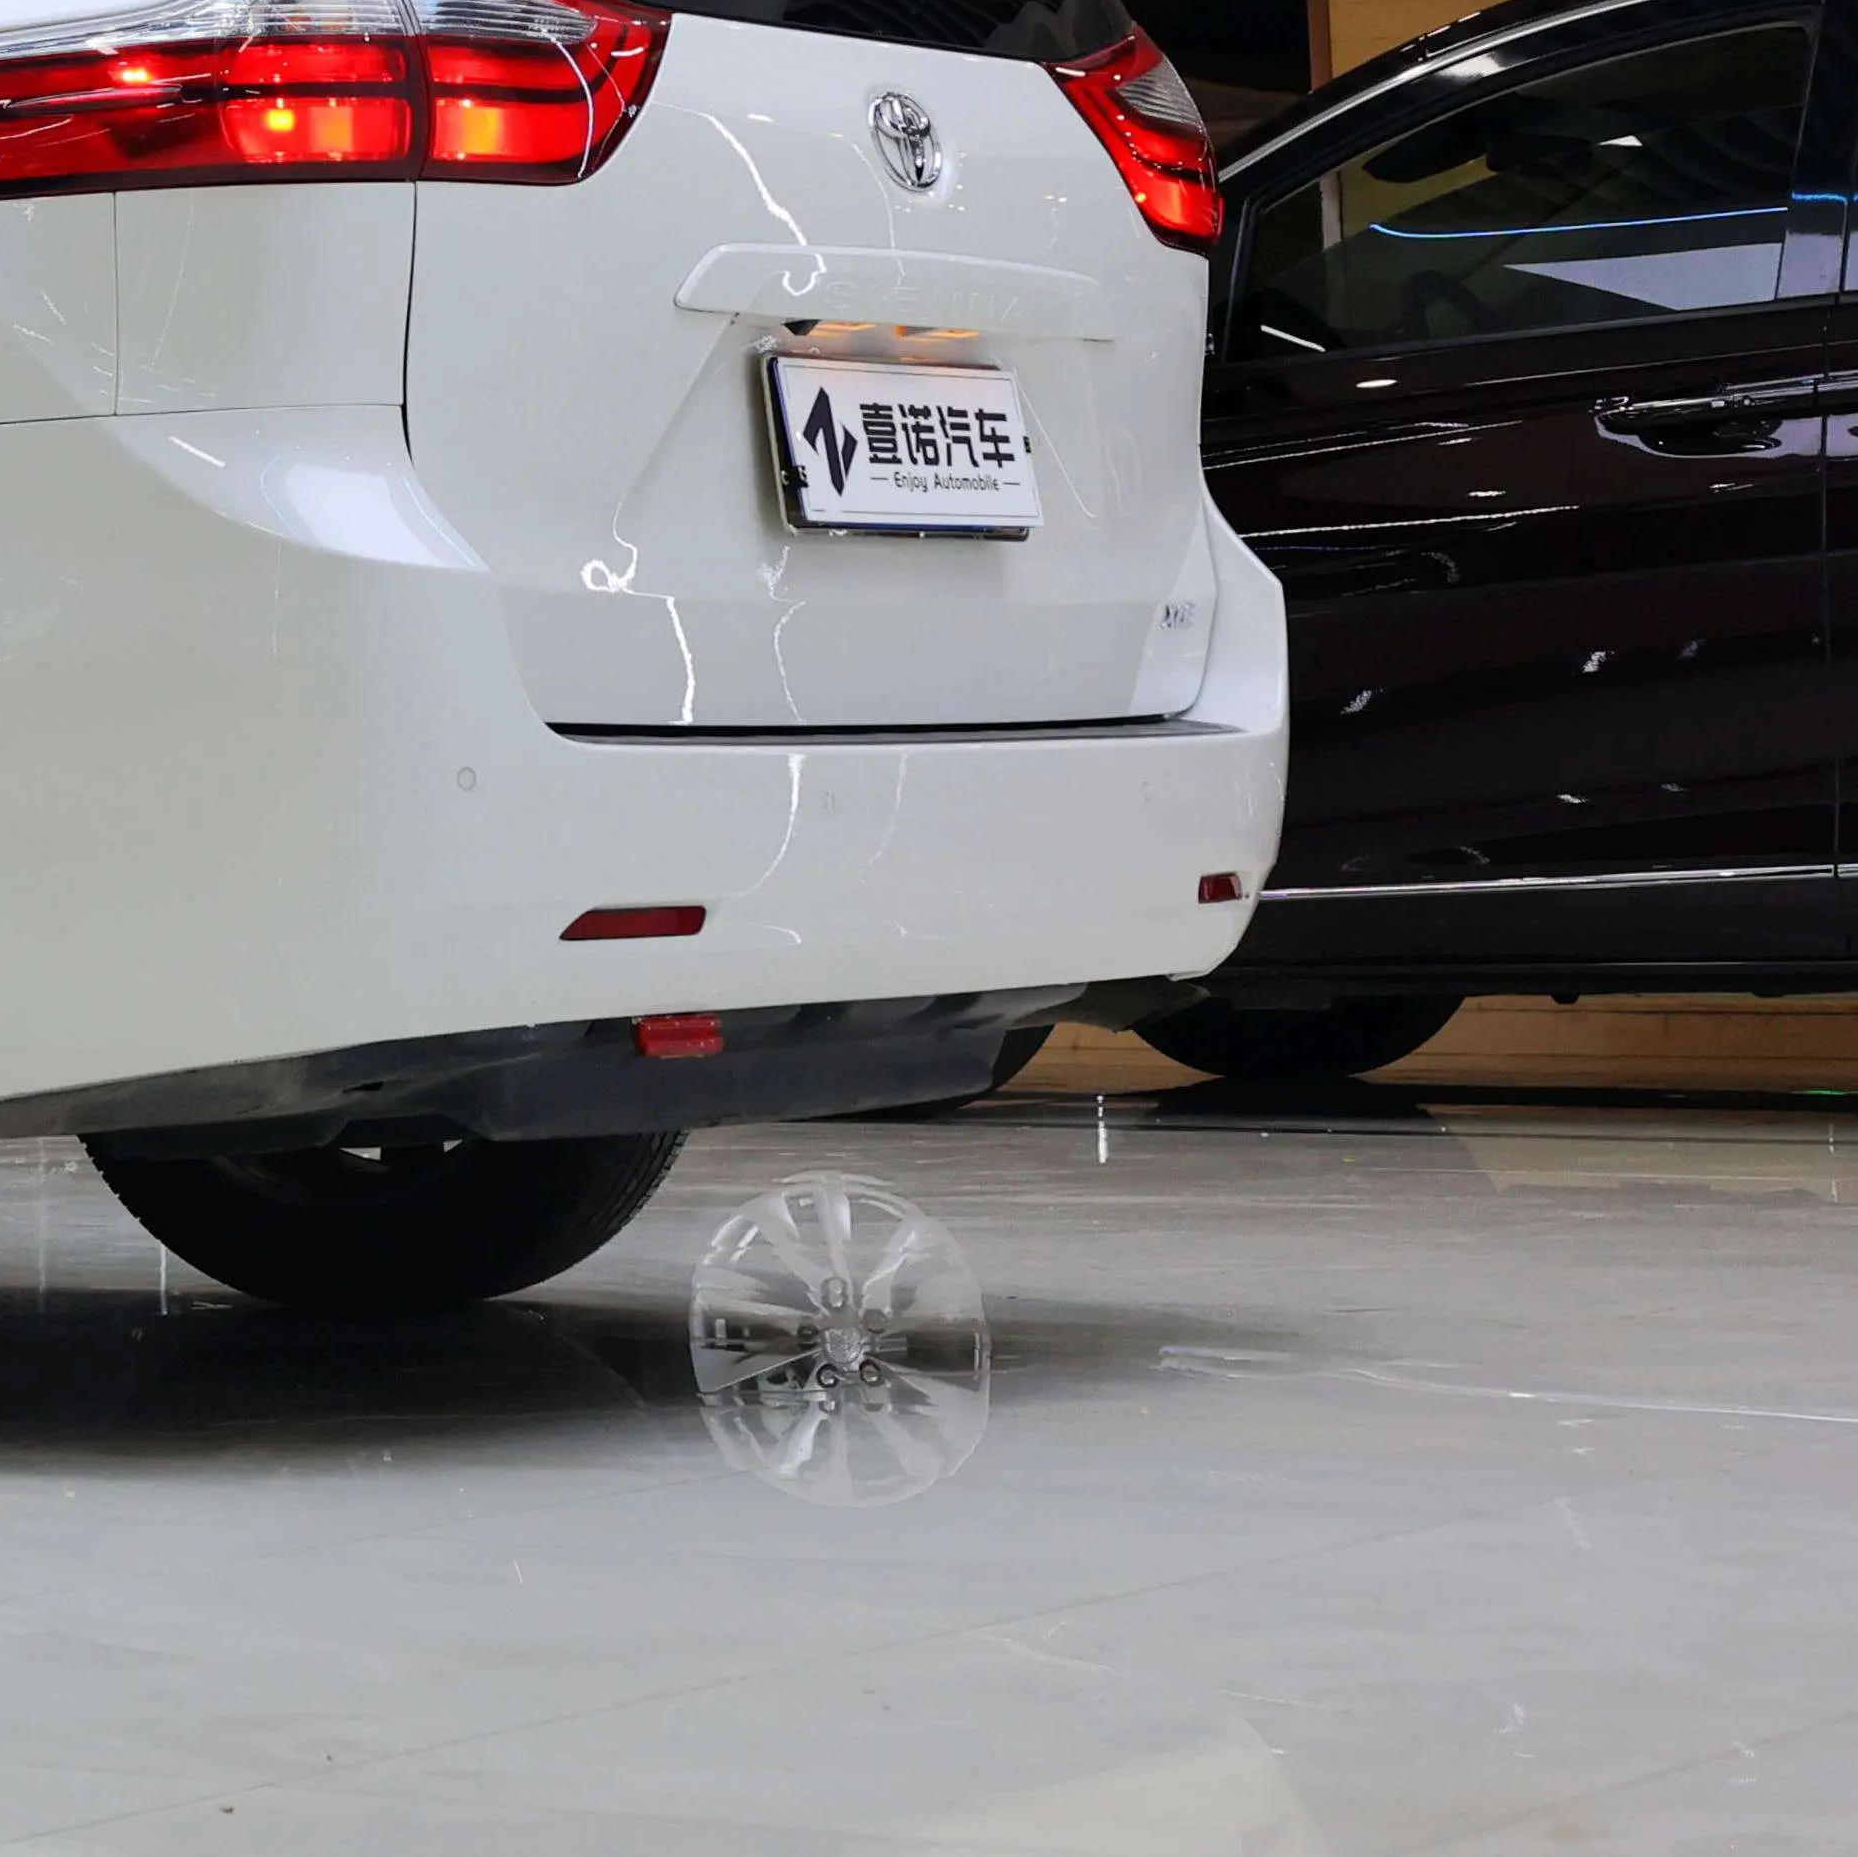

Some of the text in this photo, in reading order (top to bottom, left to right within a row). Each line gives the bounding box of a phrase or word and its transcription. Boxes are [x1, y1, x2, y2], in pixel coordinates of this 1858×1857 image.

[860, 402, 1015, 468] 壹诺汽车
[893, 471, 1000, 493] Enjoy Automobile
